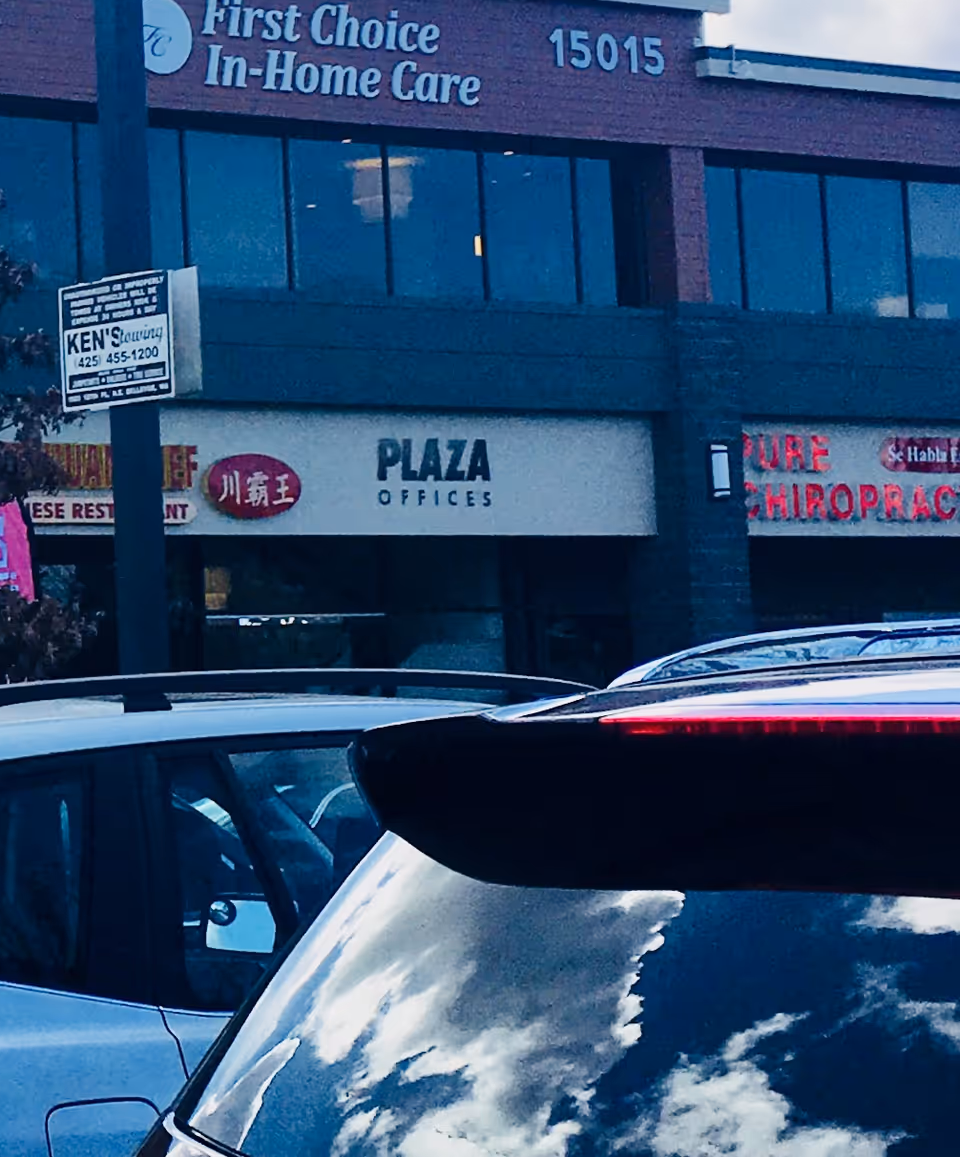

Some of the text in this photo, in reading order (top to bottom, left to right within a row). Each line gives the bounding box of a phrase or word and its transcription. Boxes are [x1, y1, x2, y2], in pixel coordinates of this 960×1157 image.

[311, 3, 440, 54] Choice
[549, 28, 665, 75] 15015
[204, 44, 481, 106] In-Home Care
[67, 326, 121, 355] KEN'S
[106, 345, 159, 364] 455-1200
[377, 438, 491, 481] PLAZA
[907, 446, 947, 462] Habla
[378, 489, 491, 507] OFFICES
[743, 481, 960, 520] CHIROPRAC
